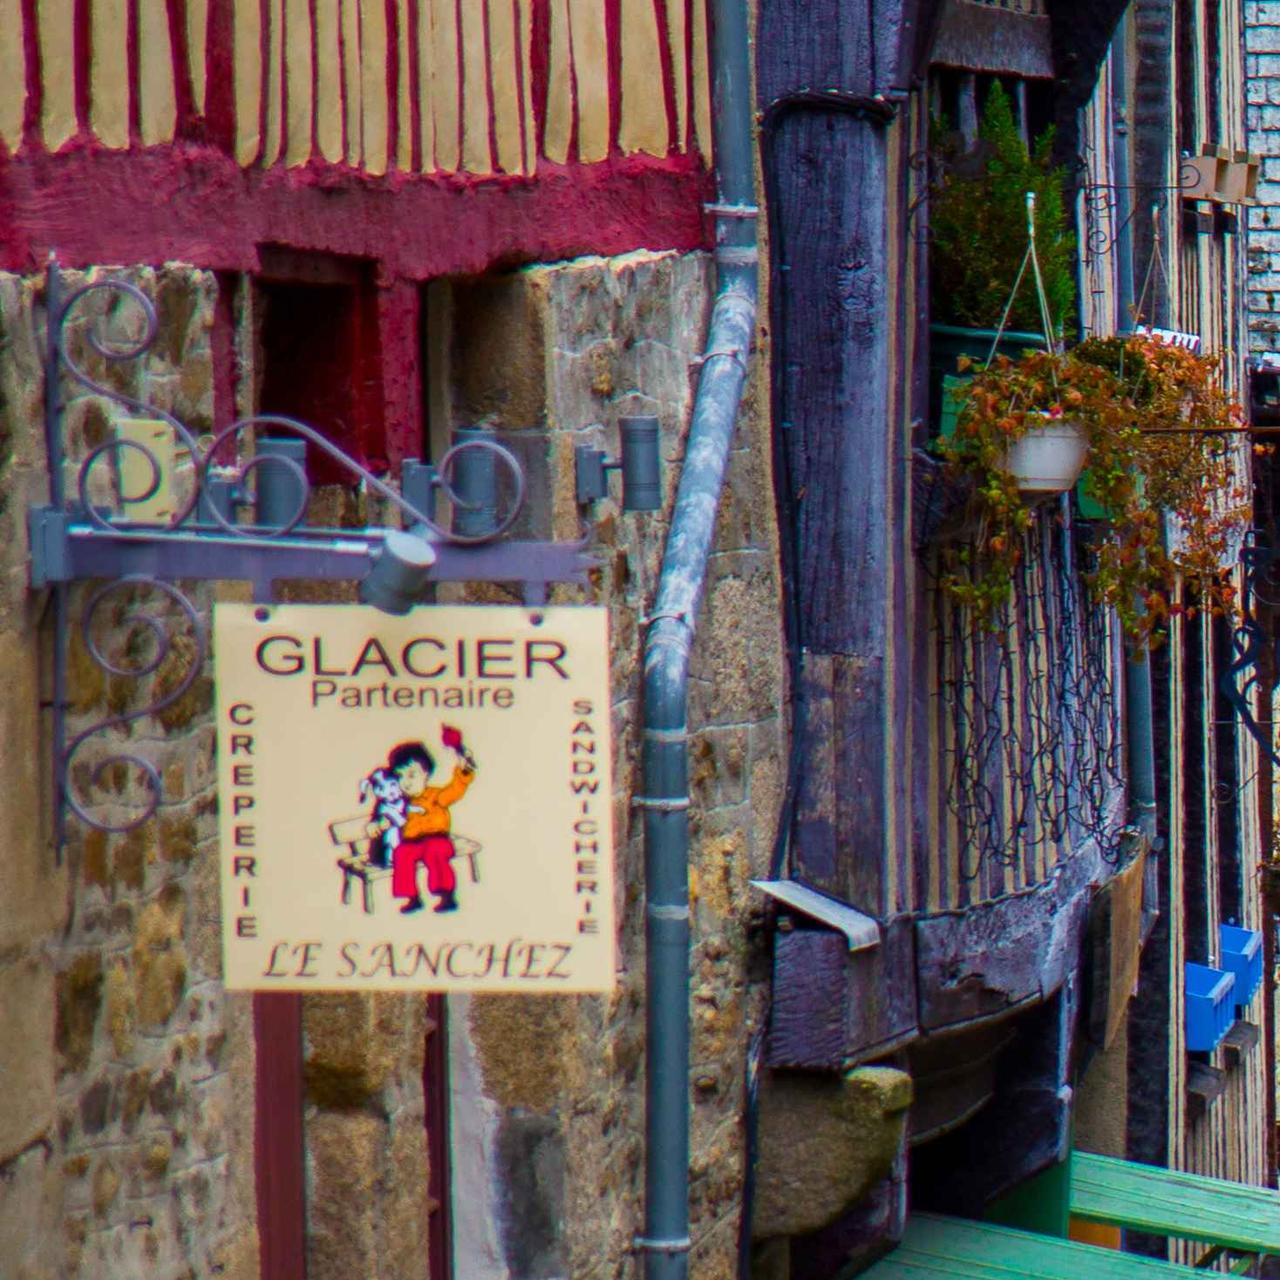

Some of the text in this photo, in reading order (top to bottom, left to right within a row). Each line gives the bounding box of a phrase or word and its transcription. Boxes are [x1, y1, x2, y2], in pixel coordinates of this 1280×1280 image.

[255, 634, 571, 680] GLACIER
[311, 679, 516, 709] Partenaire
[228, 702, 258, 938] CREPERIE
[568, 699, 600, 935] SANDWICHERIE
[262, 937, 575, 979] LE SANCHEZ
